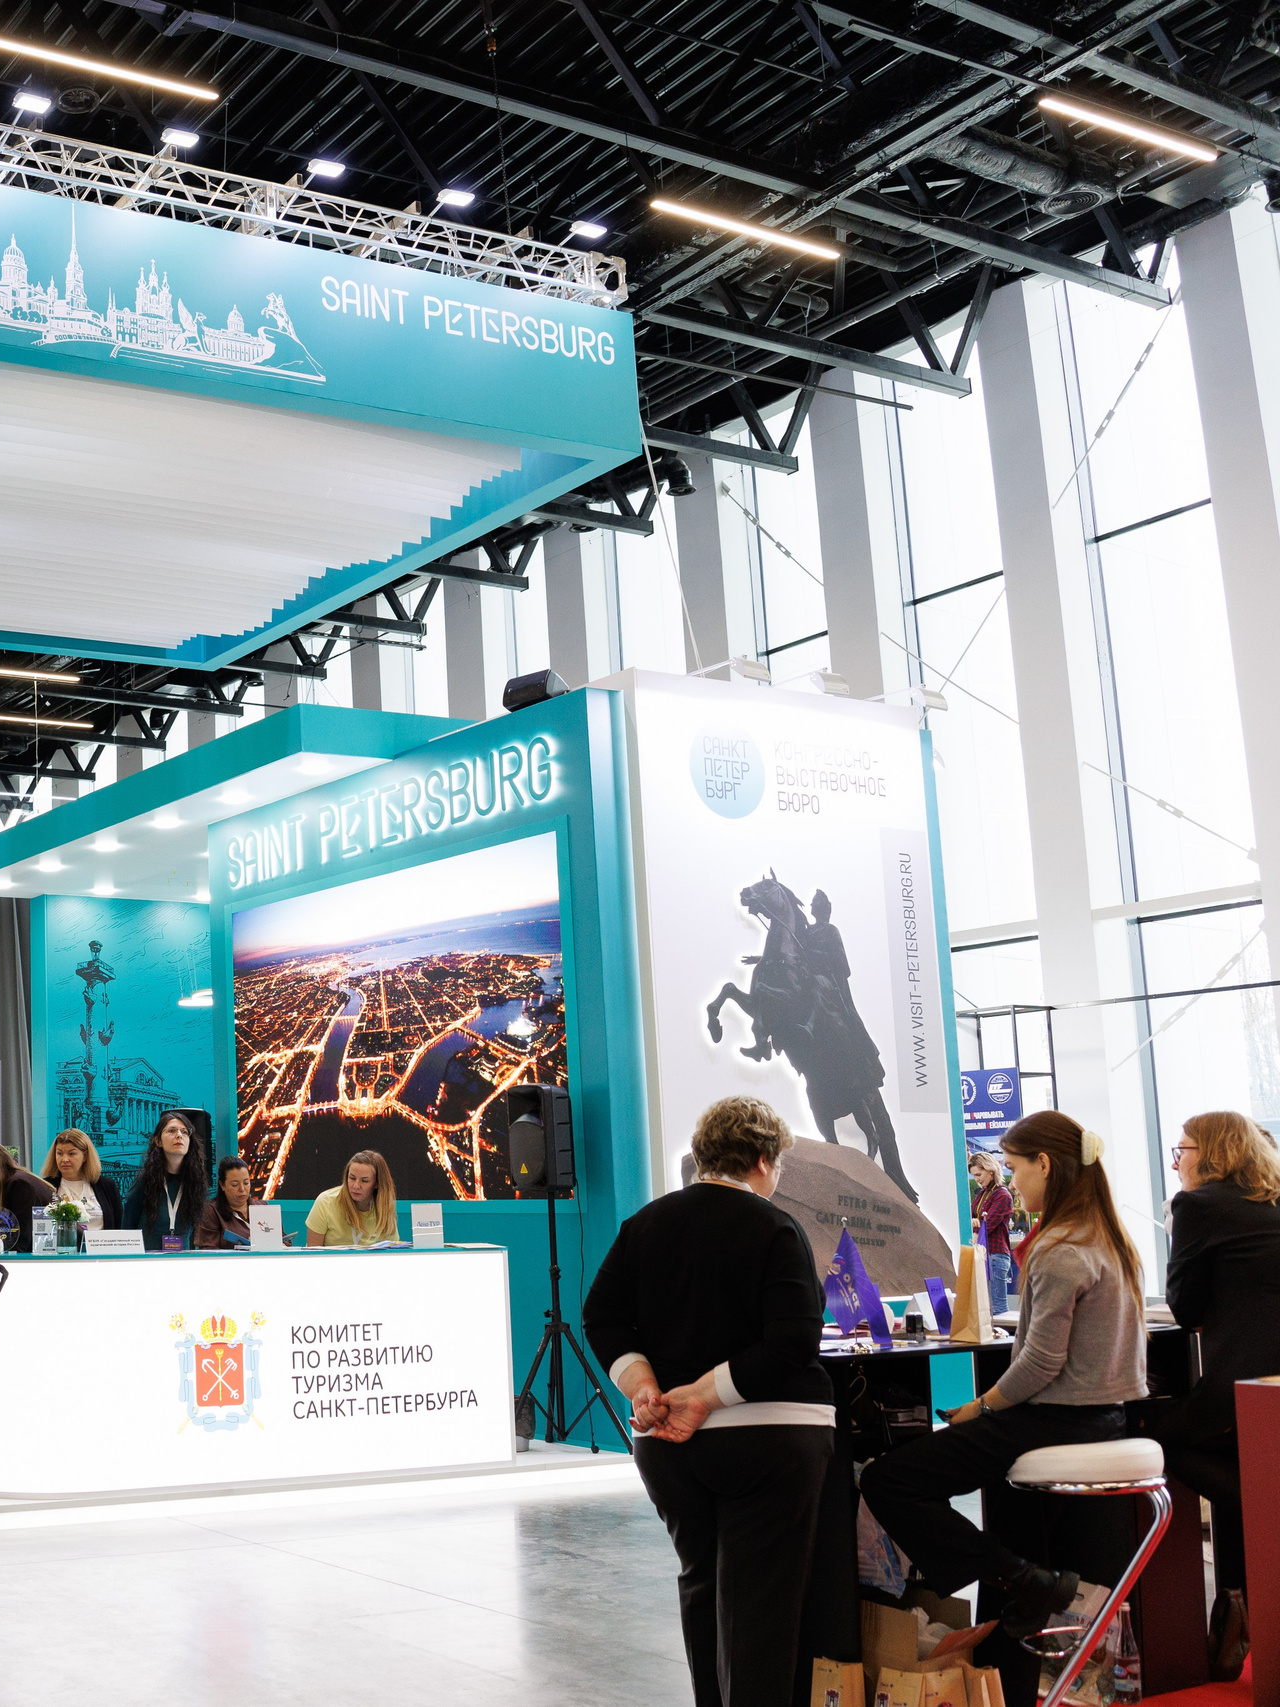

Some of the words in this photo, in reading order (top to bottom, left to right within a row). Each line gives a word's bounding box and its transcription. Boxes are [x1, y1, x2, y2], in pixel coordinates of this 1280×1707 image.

[320, 275, 410, 325] SAINT
[423, 295, 615, 365] PETERSBURG
[702, 735, 748, 759] САНКТ
[773, 740, 879, 771] КОНГРЕССНО-
[703, 757, 751, 780] ПЕТЕР
[705, 779, 742, 801] БУРГ
[776, 765, 887, 798] ВЫСТАВОЧНОЕ
[227, 813, 307, 891] SAINT
[319, 735, 555, 866] PETERSBURG
[777, 790, 821, 815] БЮРО
[838, 1194, 868, 1210] PETRO
[291, 1322, 383, 1345] КОМИТЕТ
[292, 1350, 321, 1369] ПО
[327, 1344, 433, 1368] РАЗВИТИЮ
[291, 1372, 384, 1394] ТУРИЗМА
[293, 1389, 478, 1419] САНКТ-ПЕТЕРБУРГА
